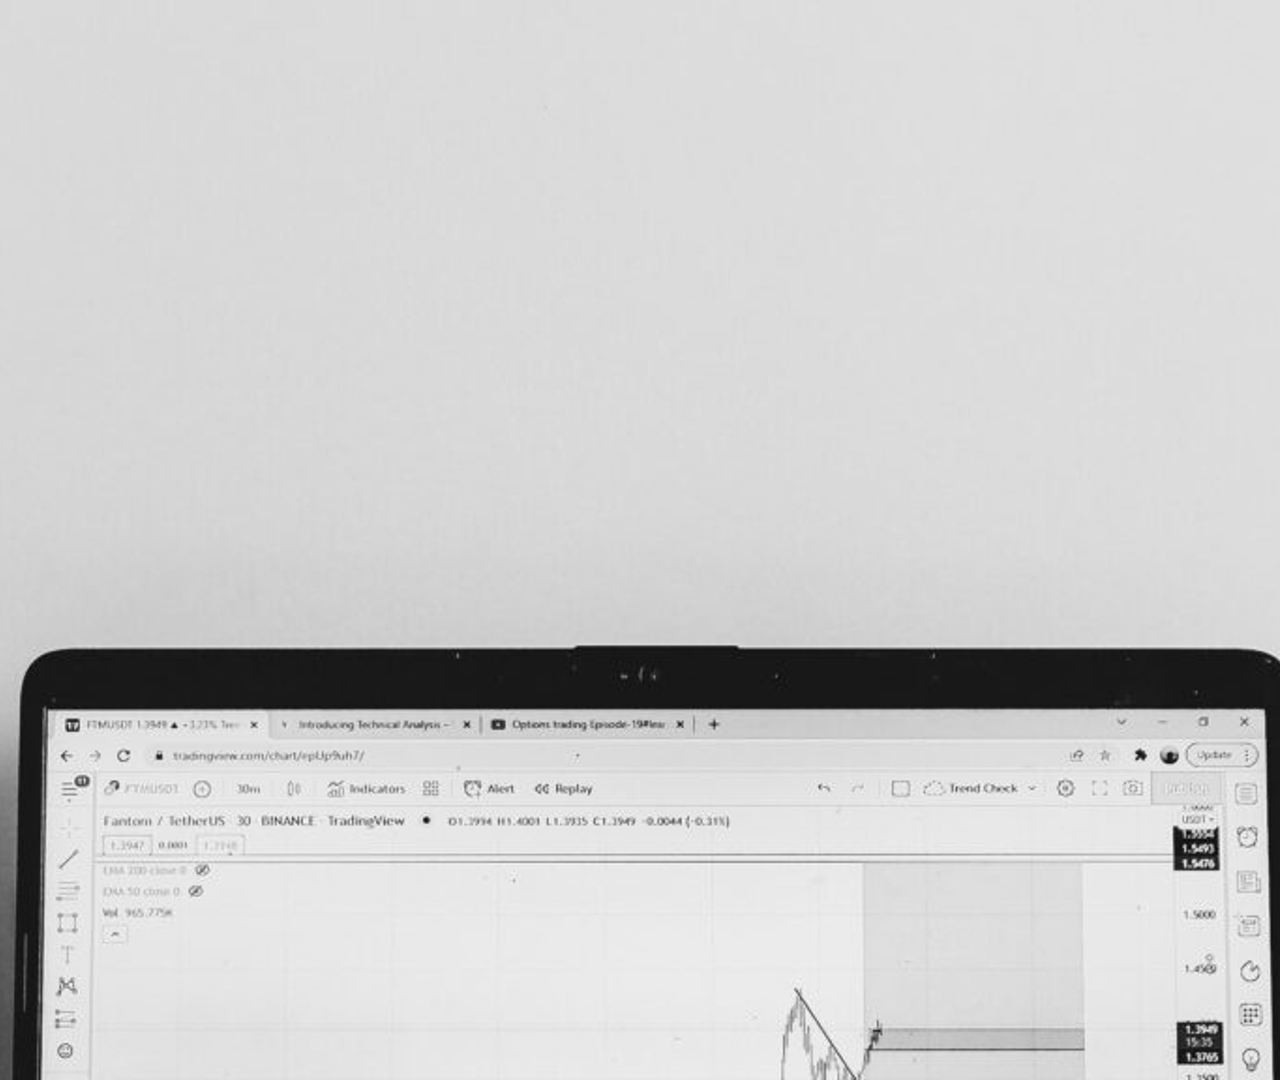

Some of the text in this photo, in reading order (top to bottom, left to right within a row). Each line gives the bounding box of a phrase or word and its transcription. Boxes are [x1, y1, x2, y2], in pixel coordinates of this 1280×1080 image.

[298, 719, 354, 731] Introducing
[358, 719, 401, 729] Technical
[402, 719, 441, 731] Analysis
[512, 719, 550, 731] Options
[552, 719, 587, 731] trading
[1197, 749, 1232, 761] Update
[236, 783, 261, 794] 30m
[349, 782, 406, 794] Indicators
[487, 783, 515, 794] Alert
[555, 783, 594, 796] Replay
[949, 782, 1018, 794] Trend Check
[103, 815, 152, 826] Fantom
[169, 815, 226, 826] TetherUS
[236, 816, 252, 826] 30
[261, 815, 314, 826] BINANCE
[328, 815, 405, 828] TradingView
[1183, 909, 1217, 919] 1.5000
[1186, 1052, 1219, 1062] 1.3765
